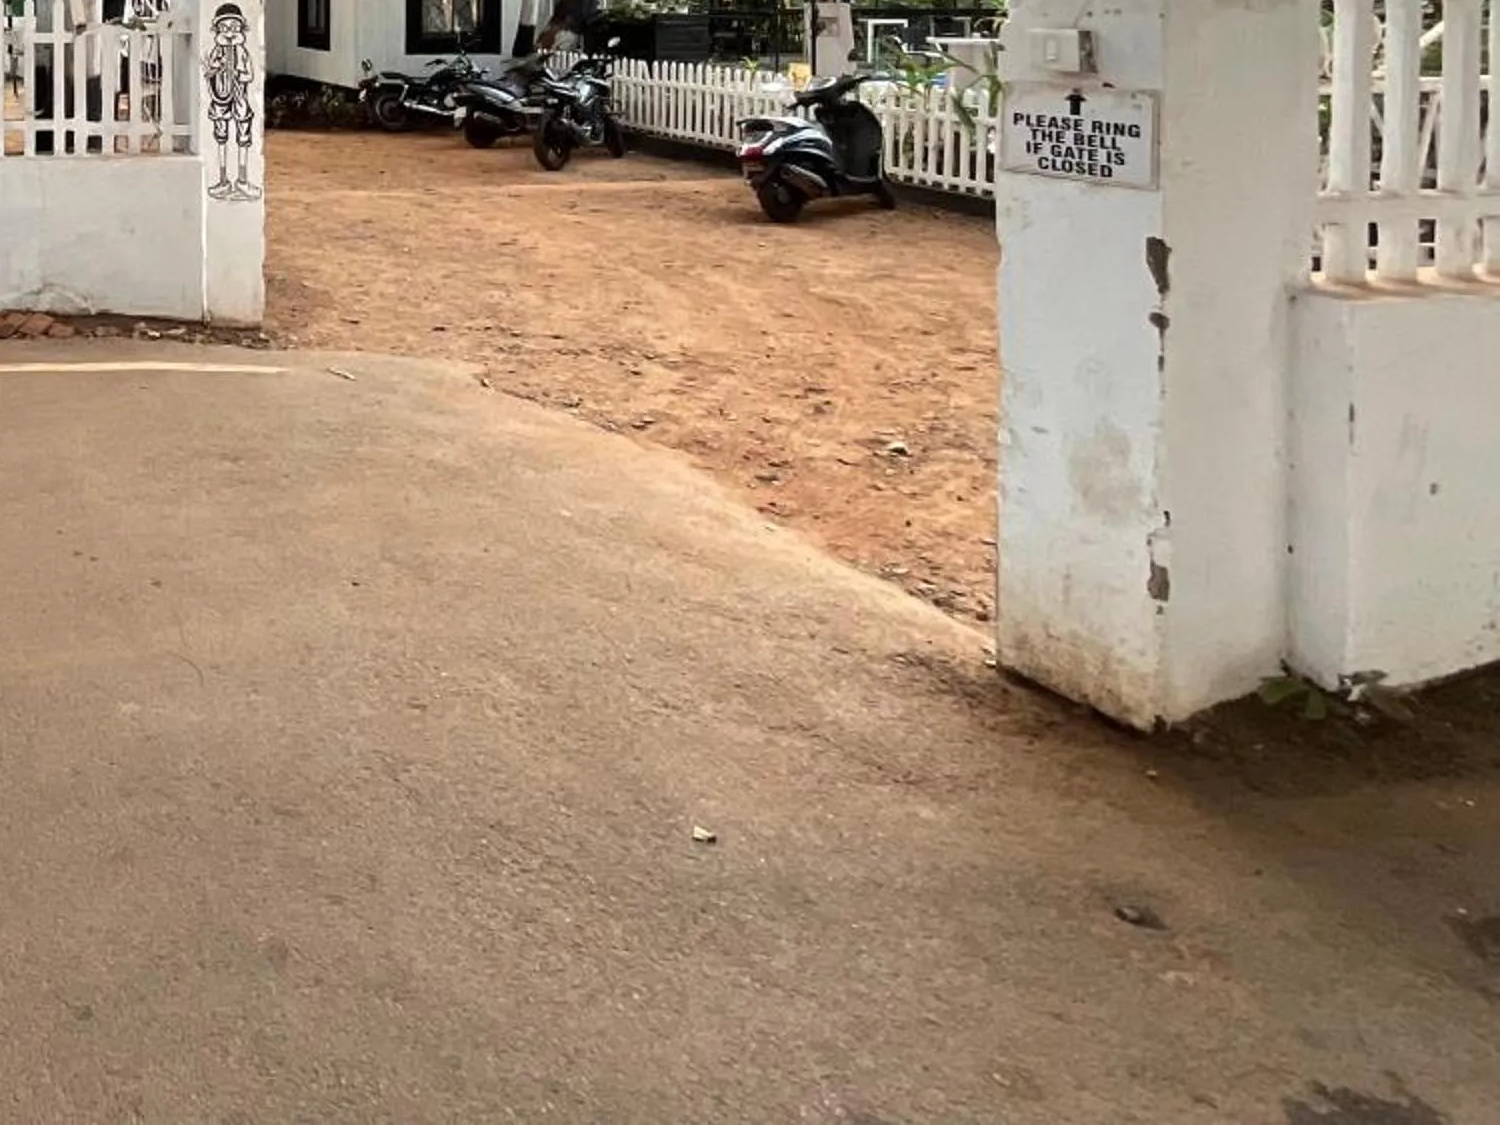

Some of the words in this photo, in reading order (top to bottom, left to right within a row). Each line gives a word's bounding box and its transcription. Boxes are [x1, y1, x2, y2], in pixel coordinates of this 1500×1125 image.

[1013, 112, 1085, 132] PLEASE
[1091, 120, 1141, 139] RING
[1030, 128, 1066, 144] THE
[1073, 132, 1122, 151] BELL
[1026, 141, 1043, 155] IF
[1050, 144, 1099, 162] GATE
[1107, 152, 1125, 166] IS
[1038, 156, 1113, 178] CLOSED
